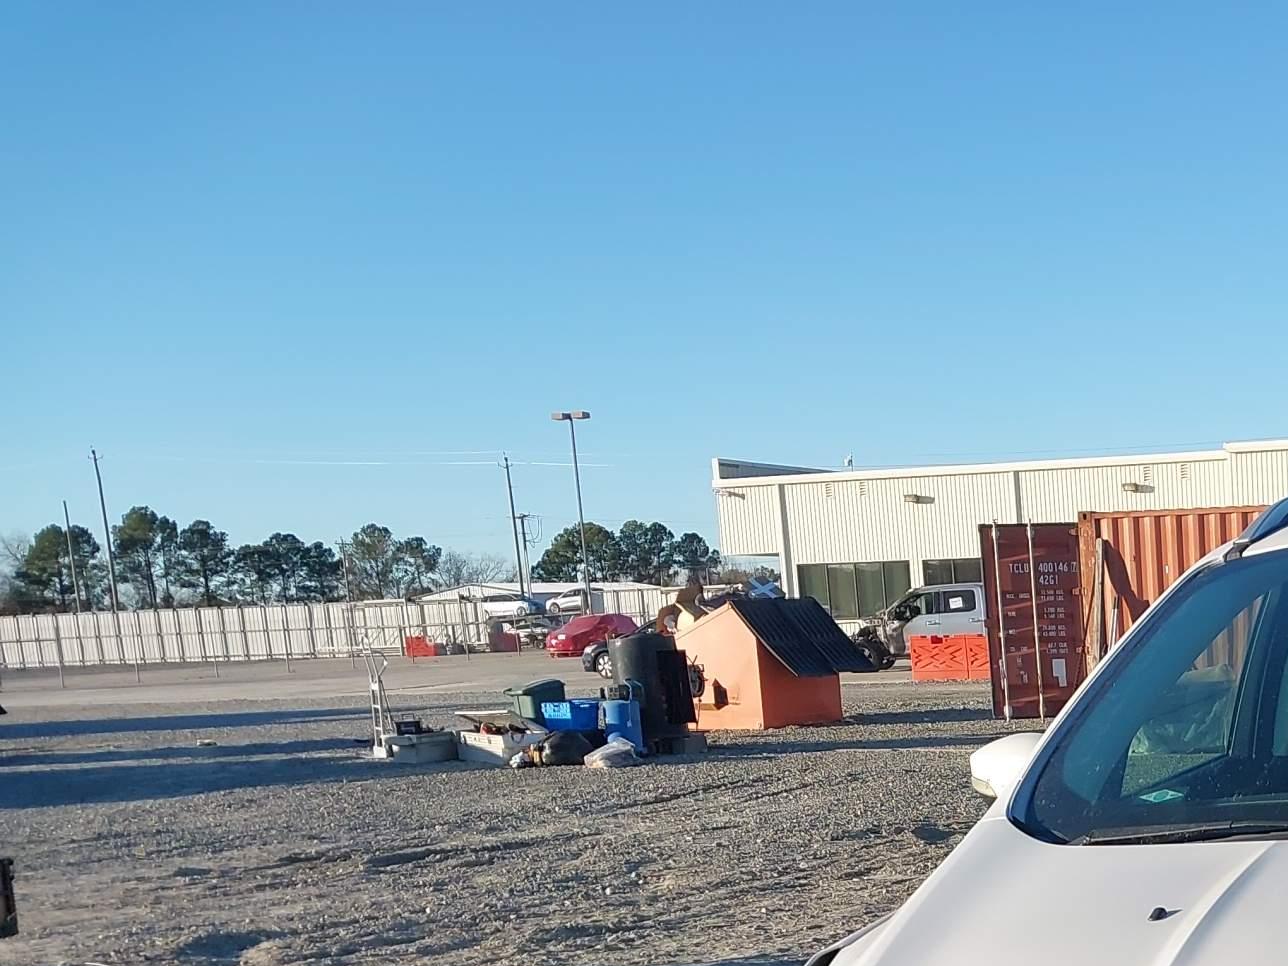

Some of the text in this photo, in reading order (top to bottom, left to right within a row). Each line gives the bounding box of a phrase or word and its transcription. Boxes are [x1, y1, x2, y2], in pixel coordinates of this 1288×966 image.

[1009, 563, 1029, 573] TCLU
[1038, 562, 1069, 573] 400146
[1039, 574, 1058, 585] 42G1
